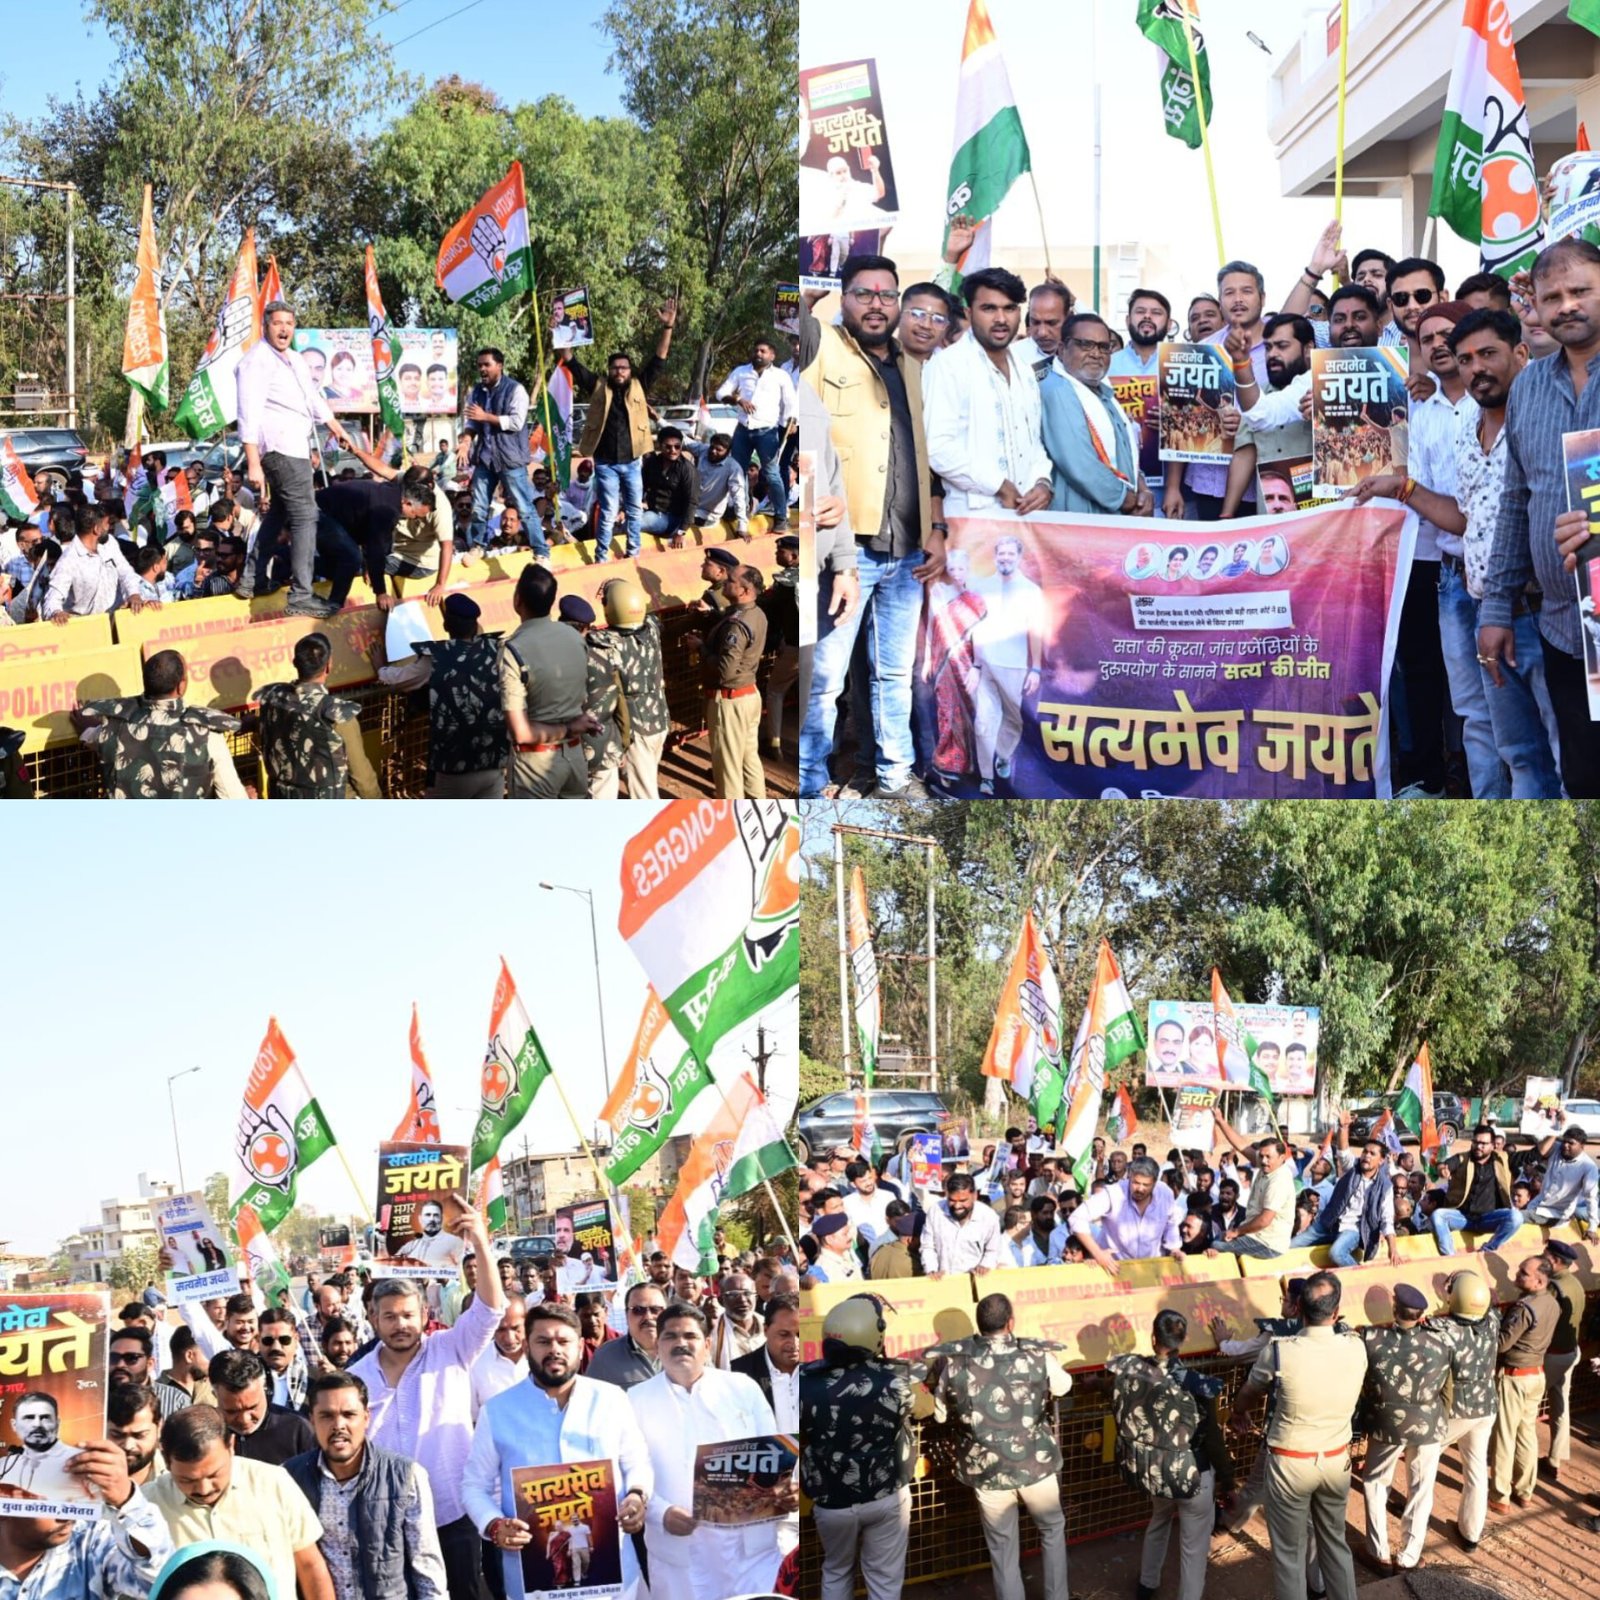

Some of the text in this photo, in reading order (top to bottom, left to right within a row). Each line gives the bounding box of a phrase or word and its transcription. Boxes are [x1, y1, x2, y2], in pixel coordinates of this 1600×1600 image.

[812, 106, 868, 135] सत्यमेव
[824, 114, 883, 153] जयते
[1169, 349, 1205, 364] सत्यमेव
[1324, 355, 1369, 373] सत्यमेव
[1163, 355, 1222, 389] जयते
[1317, 361, 1391, 403] जयते
[1277, 606, 1287, 615] ED
[1146, 635, 1166, 656] की
[1168, 639, 1206, 661] क्रूरता,
[1209, 637, 1236, 656] जांच
[1238, 634, 1301, 656] एजेंसियों
[1303, 634, 1319, 654] के
[1162, 660, 1176, 678] के
[1177, 659, 1218, 680] सामने
[1270, 654, 1295, 677] की
[1296, 655, 1331, 679] जीत
[0, 680, 77, 721] POLICE
[1037, 689, 1382, 785] सत्यमेव जयते
[1179, 1091, 1217, 1107] जयते
[388, 1148, 441, 1167] सत्यमेव
[384, 1154, 464, 1194] जयते
[394, 1203, 416, 1214] मगर
[581, 1231, 612, 1251] जयते
[175, 1275, 208, 1292] सत्यमेव
[0, 1310, 97, 1377] यते
[702, 1443, 784, 1473] जयते
[521, 1464, 607, 1505] सत्यमेव
[2, 1502, 23, 1513] युवा
[535, 1491, 594, 1528] जयते
